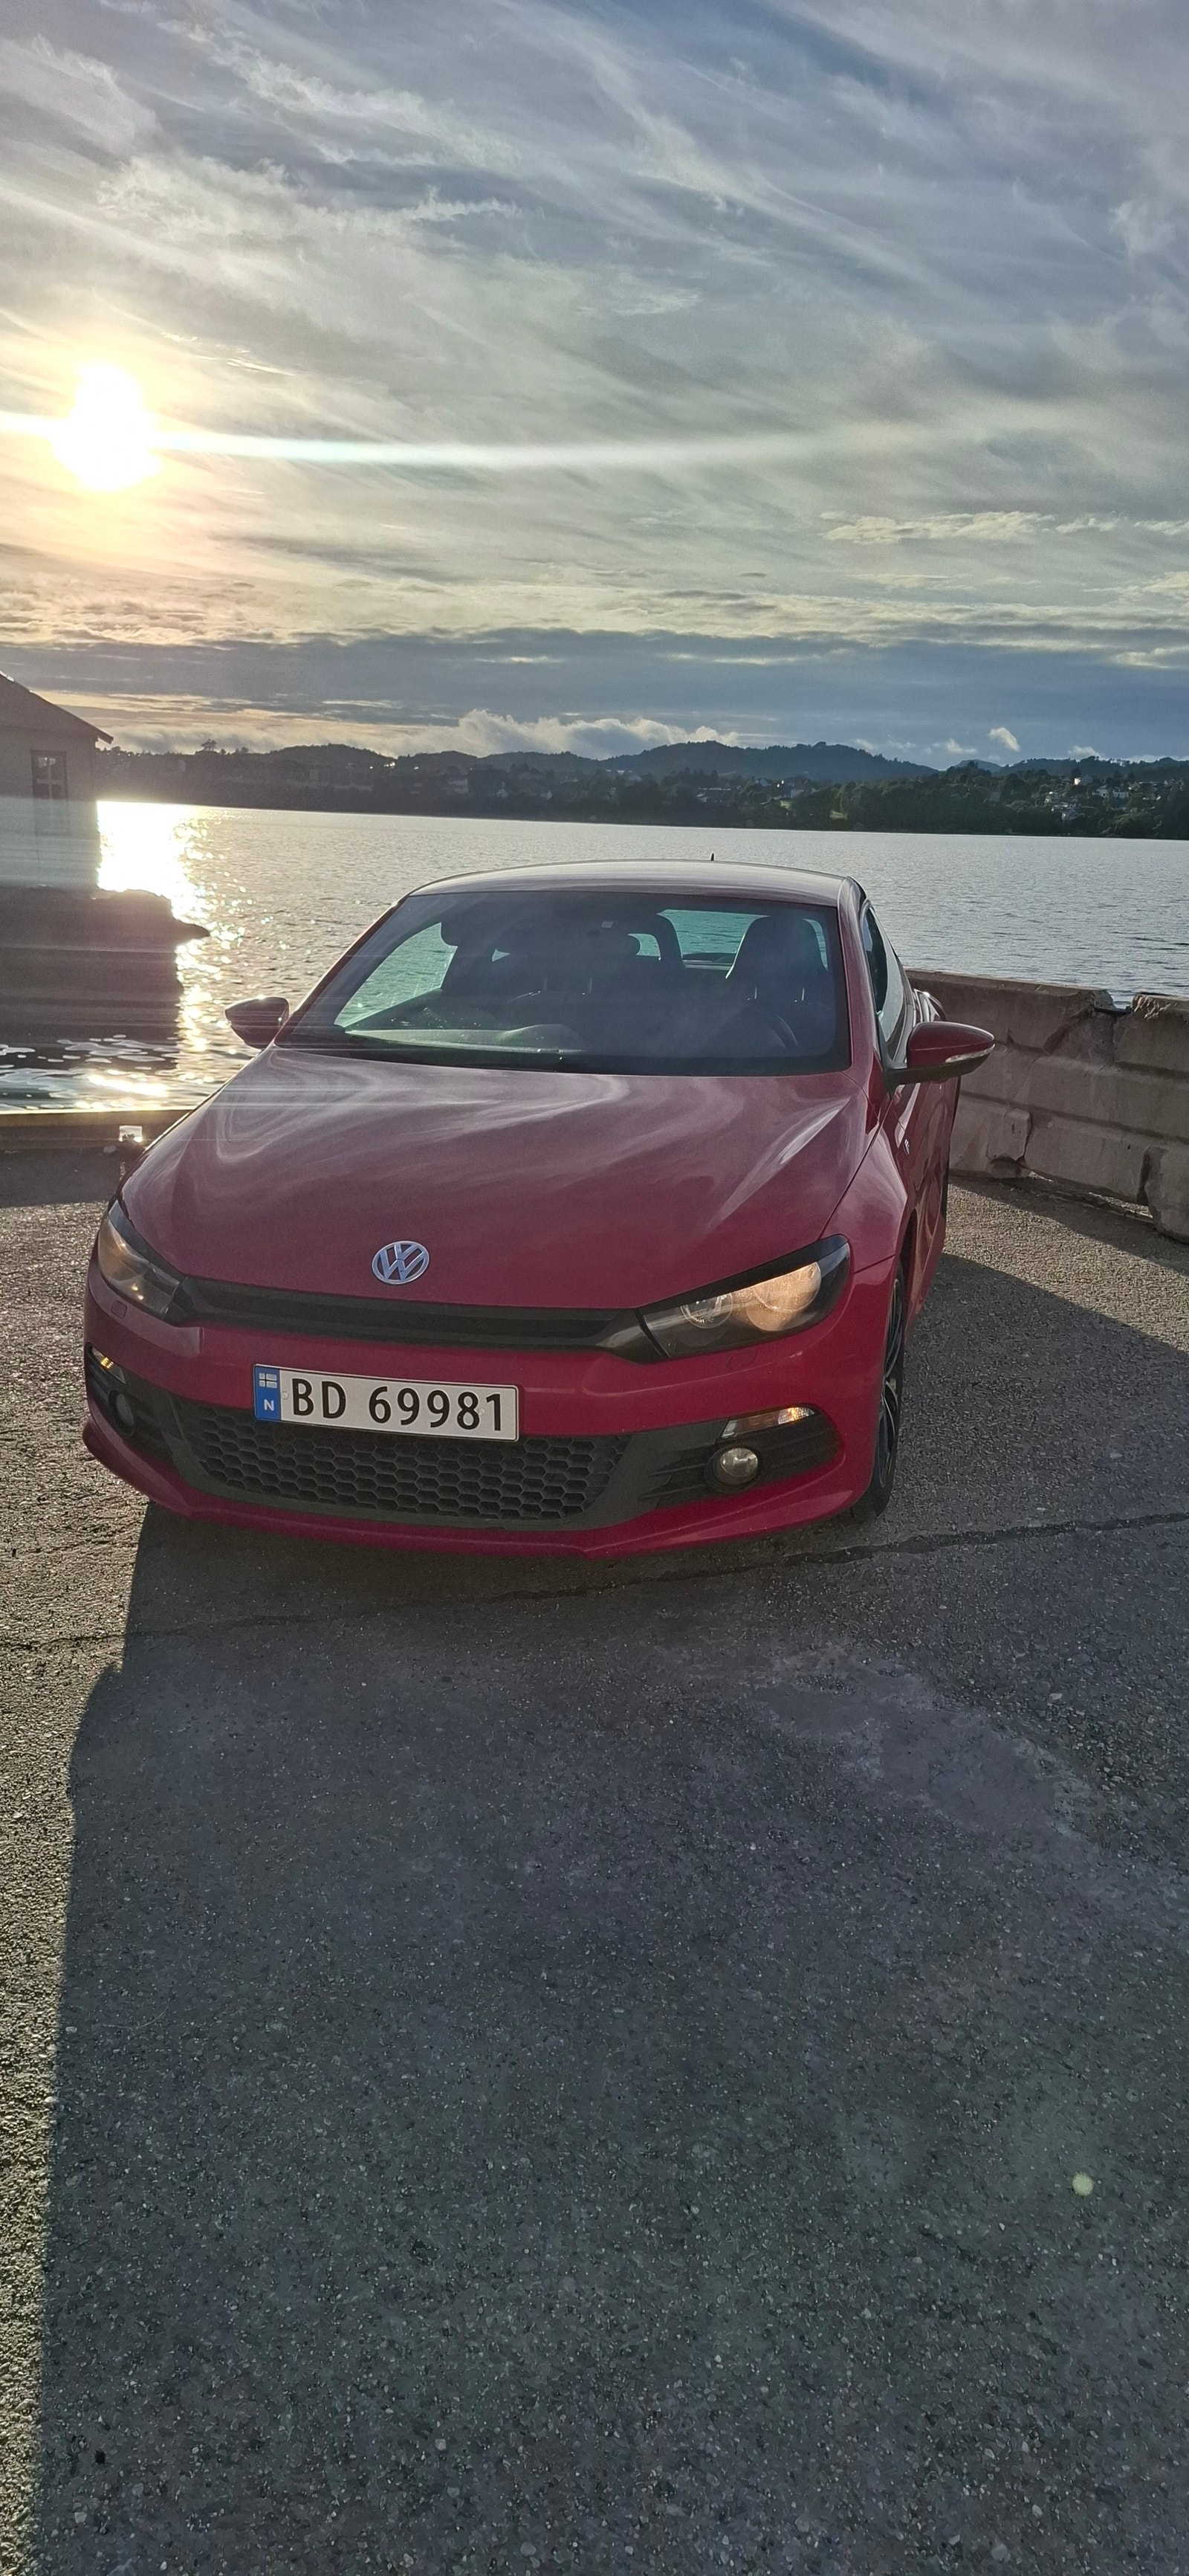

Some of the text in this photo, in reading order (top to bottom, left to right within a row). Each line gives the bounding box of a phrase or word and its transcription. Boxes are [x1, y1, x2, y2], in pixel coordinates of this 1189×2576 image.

[375, 1241, 428, 1283] VW
[264, 1399, 275, 1412] N
[292, 1378, 501, 1431] BD 69981
